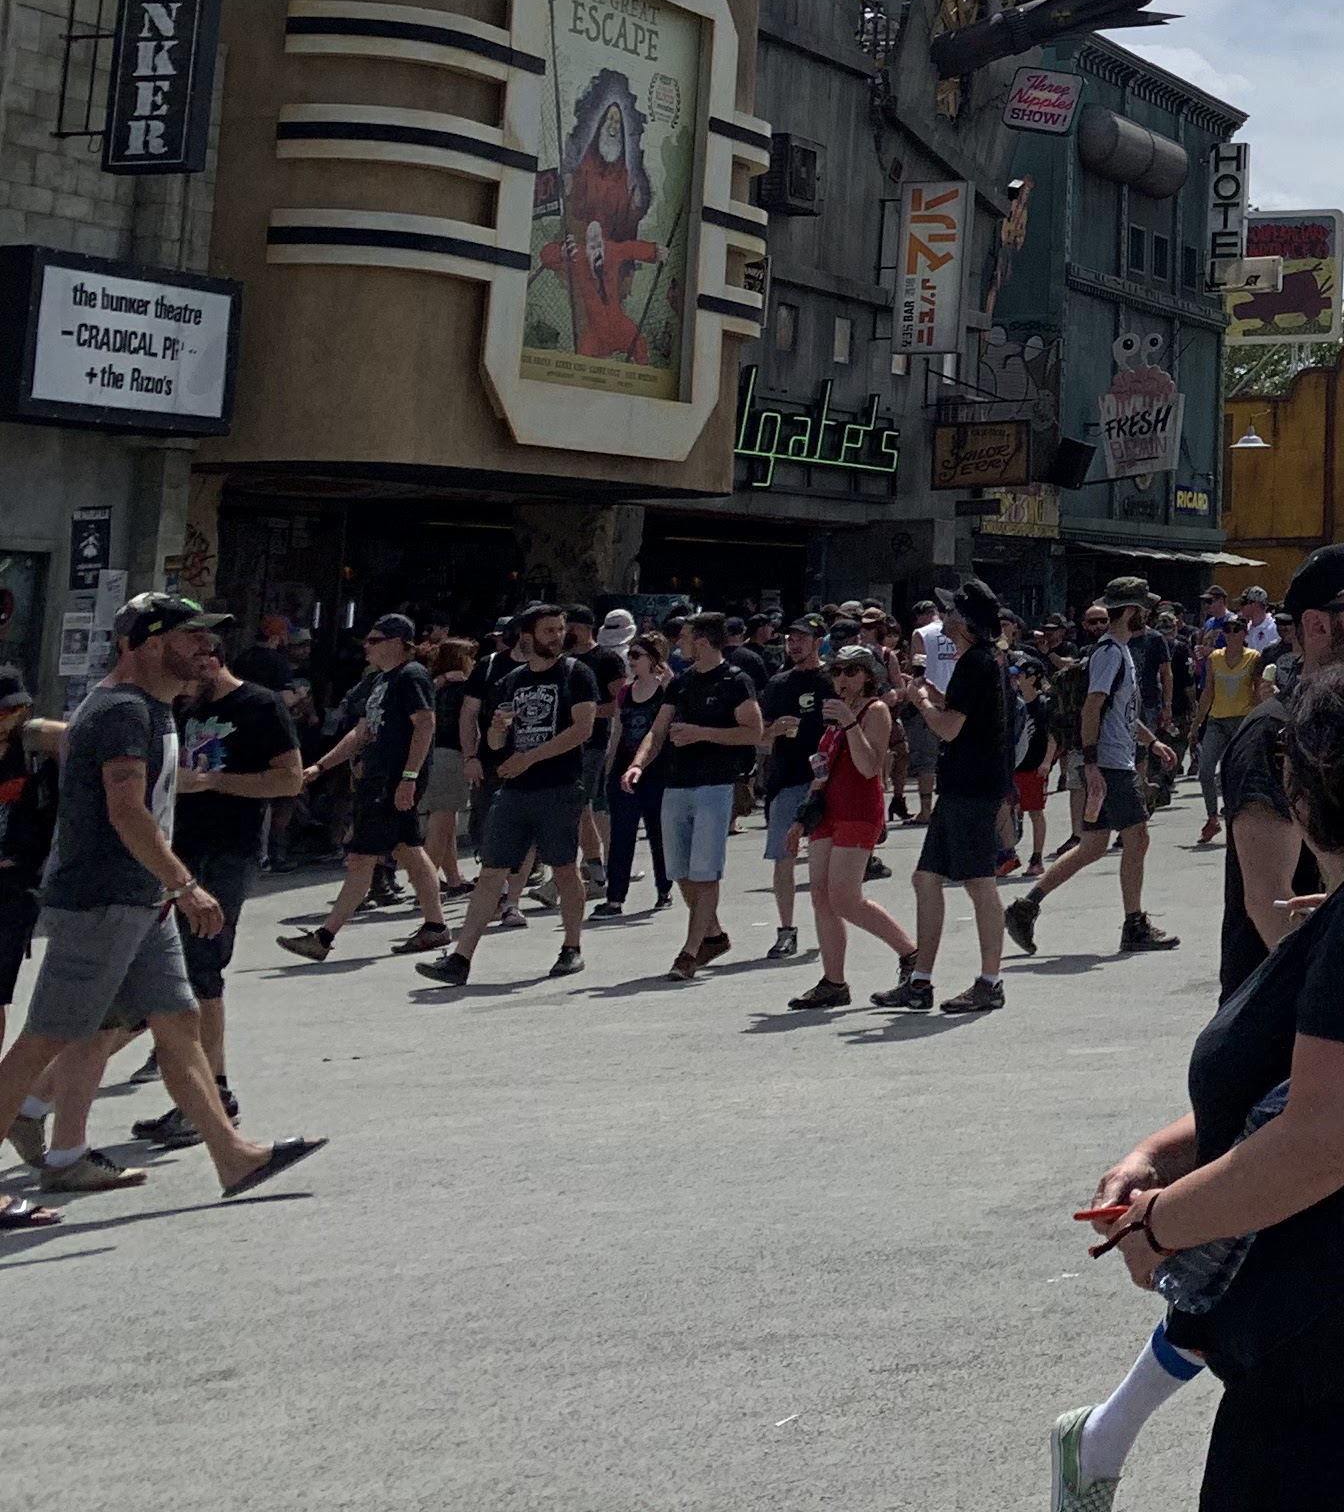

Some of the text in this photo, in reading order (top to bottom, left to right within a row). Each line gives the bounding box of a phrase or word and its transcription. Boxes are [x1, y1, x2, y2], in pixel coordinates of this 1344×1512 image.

[568, 0, 660, 62] ESCAPE
[1009, 88, 1075, 111] Nipples
[1026, 74, 1071, 97] Three
[1010, 108, 1068, 127] SHOW!
[1205, 144, 1242, 291] HOTEL
[72, 283, 203, 326] the bunker theatre
[1104, 405, 1173, 440] FRESH
[1176, 490, 1209, 510] RICARD
